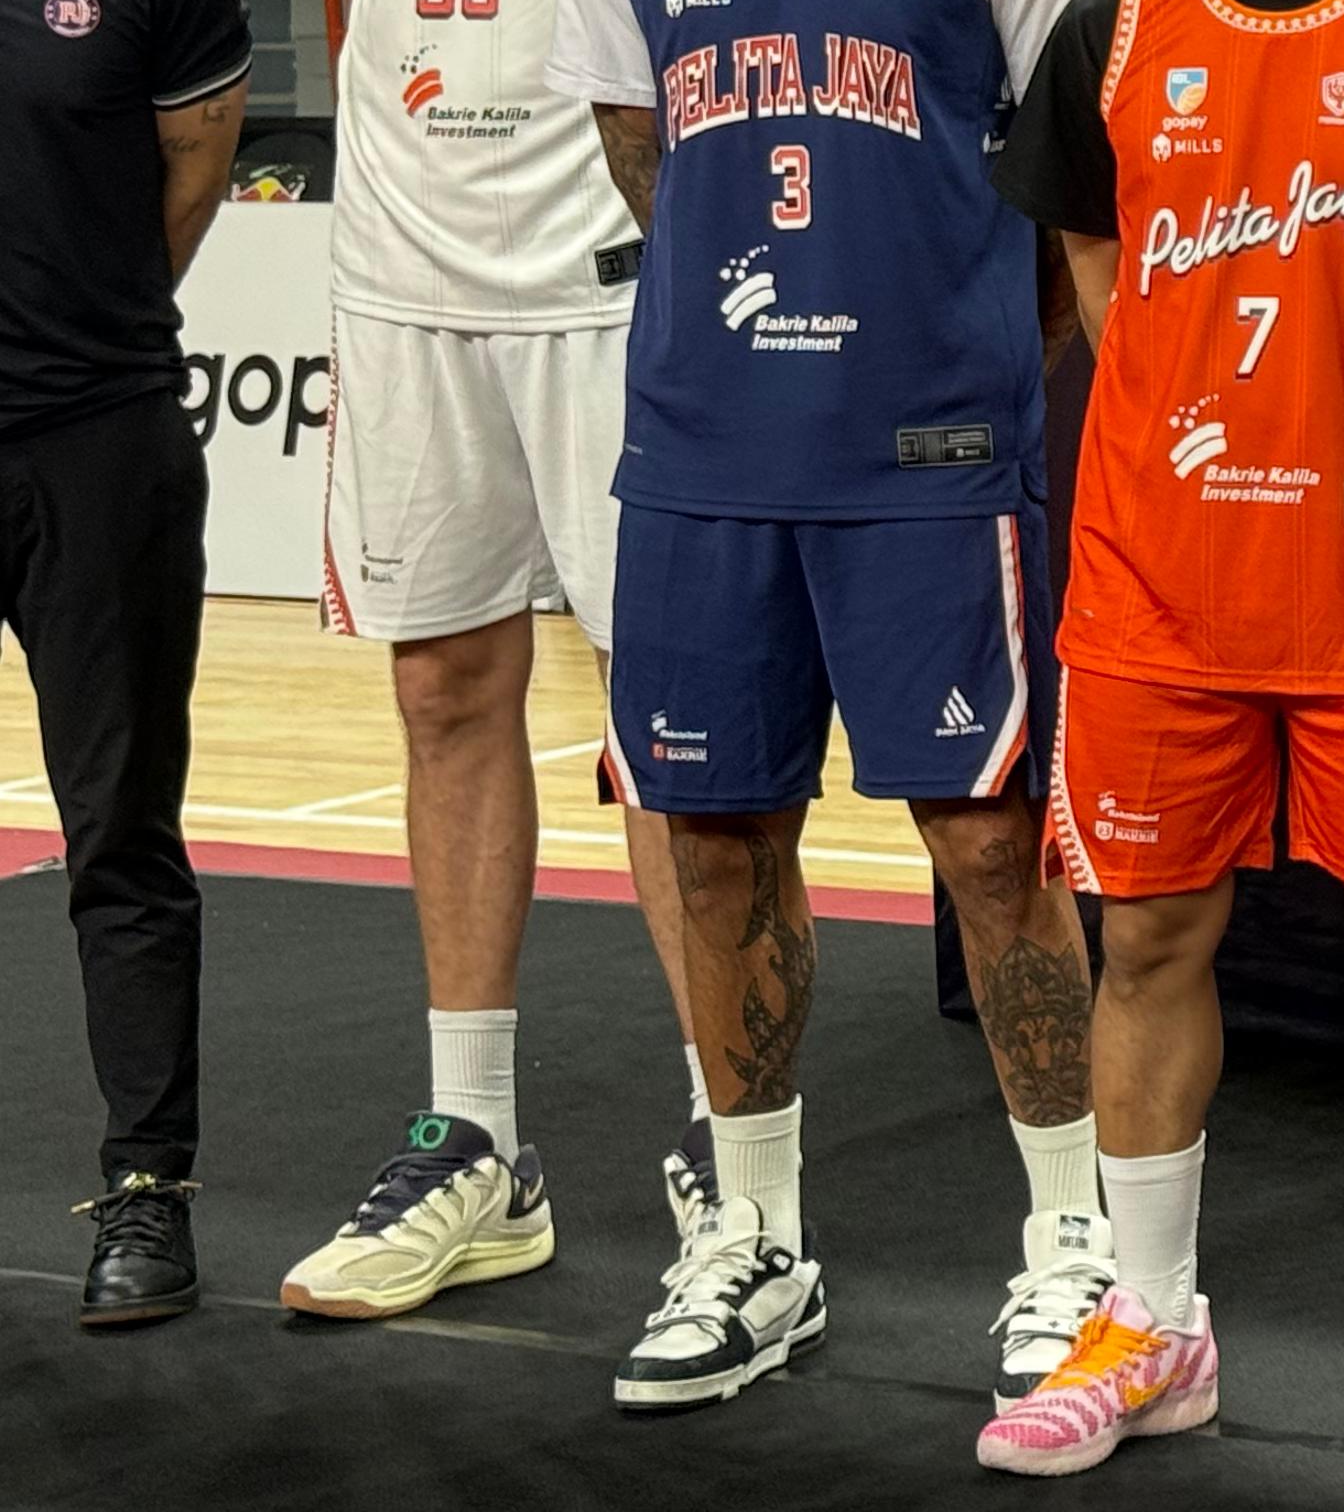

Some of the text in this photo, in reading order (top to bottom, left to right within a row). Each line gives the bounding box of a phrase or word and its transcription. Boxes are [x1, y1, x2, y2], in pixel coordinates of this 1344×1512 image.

[663, 32, 923, 154] PELITA JAYA
[427, 106, 478, 121] Bakrie
[426, 124, 516, 139] Investment
[1162, 115, 1209, 133] gopay
[1174, 138, 1223, 154] MILLS
[771, 144, 813, 230] 3
[1140, 186, 1280, 297] Pelita
[754, 314, 807, 333] Bakrie
[752, 334, 841, 353] Investment
[1235, 296, 1280, 380] 7
[1203, 463, 1265, 486] Bakrie
[1200, 485, 1303, 505] Investment
